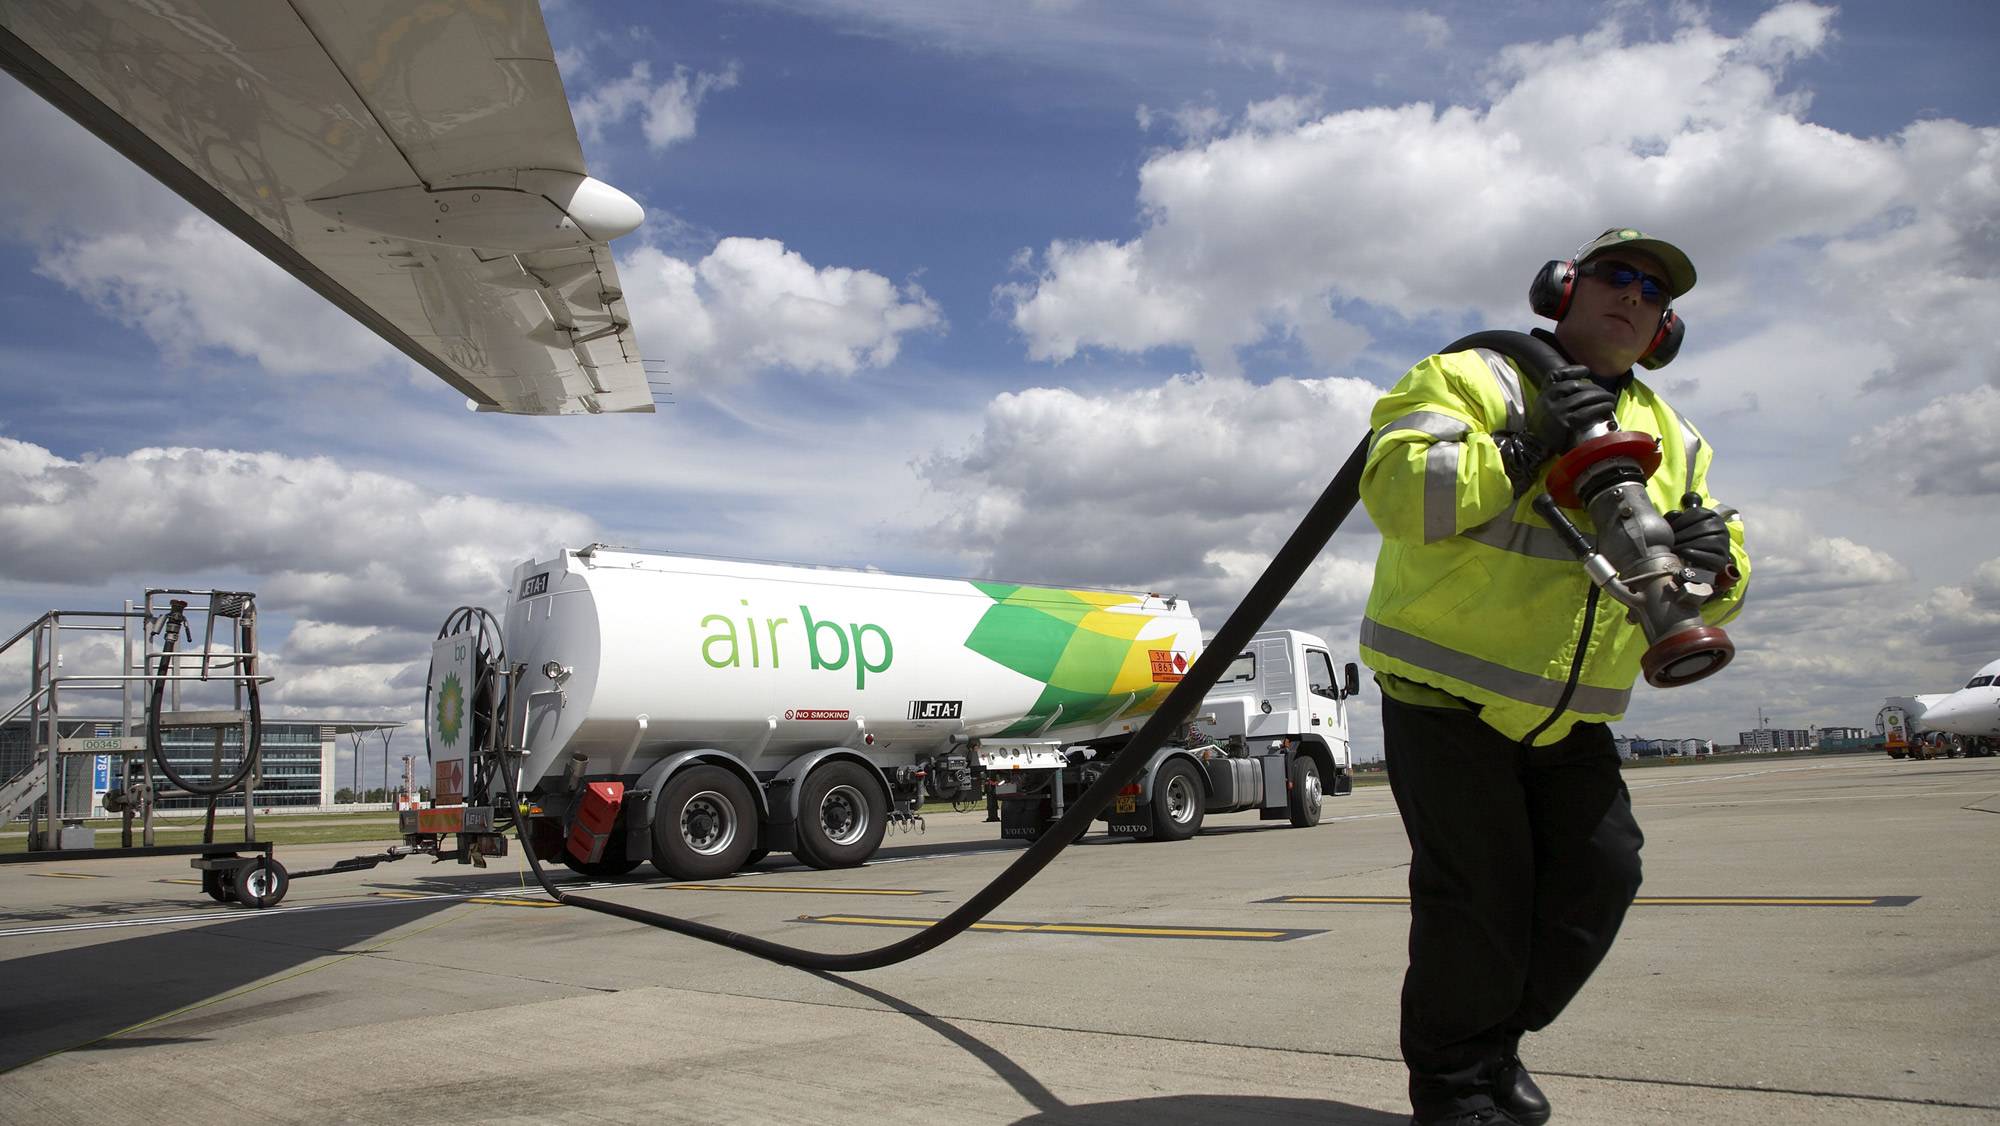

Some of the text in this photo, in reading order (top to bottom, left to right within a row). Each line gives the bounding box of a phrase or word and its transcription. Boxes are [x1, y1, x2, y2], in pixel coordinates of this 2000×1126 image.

[701, 599, 894, 690] air bp
[454, 643, 466, 665] bp
[1153, 663, 1173, 672] 1863
[86, 740, 119, 749] 00345
[1112, 824, 1148, 832] VOLVO
